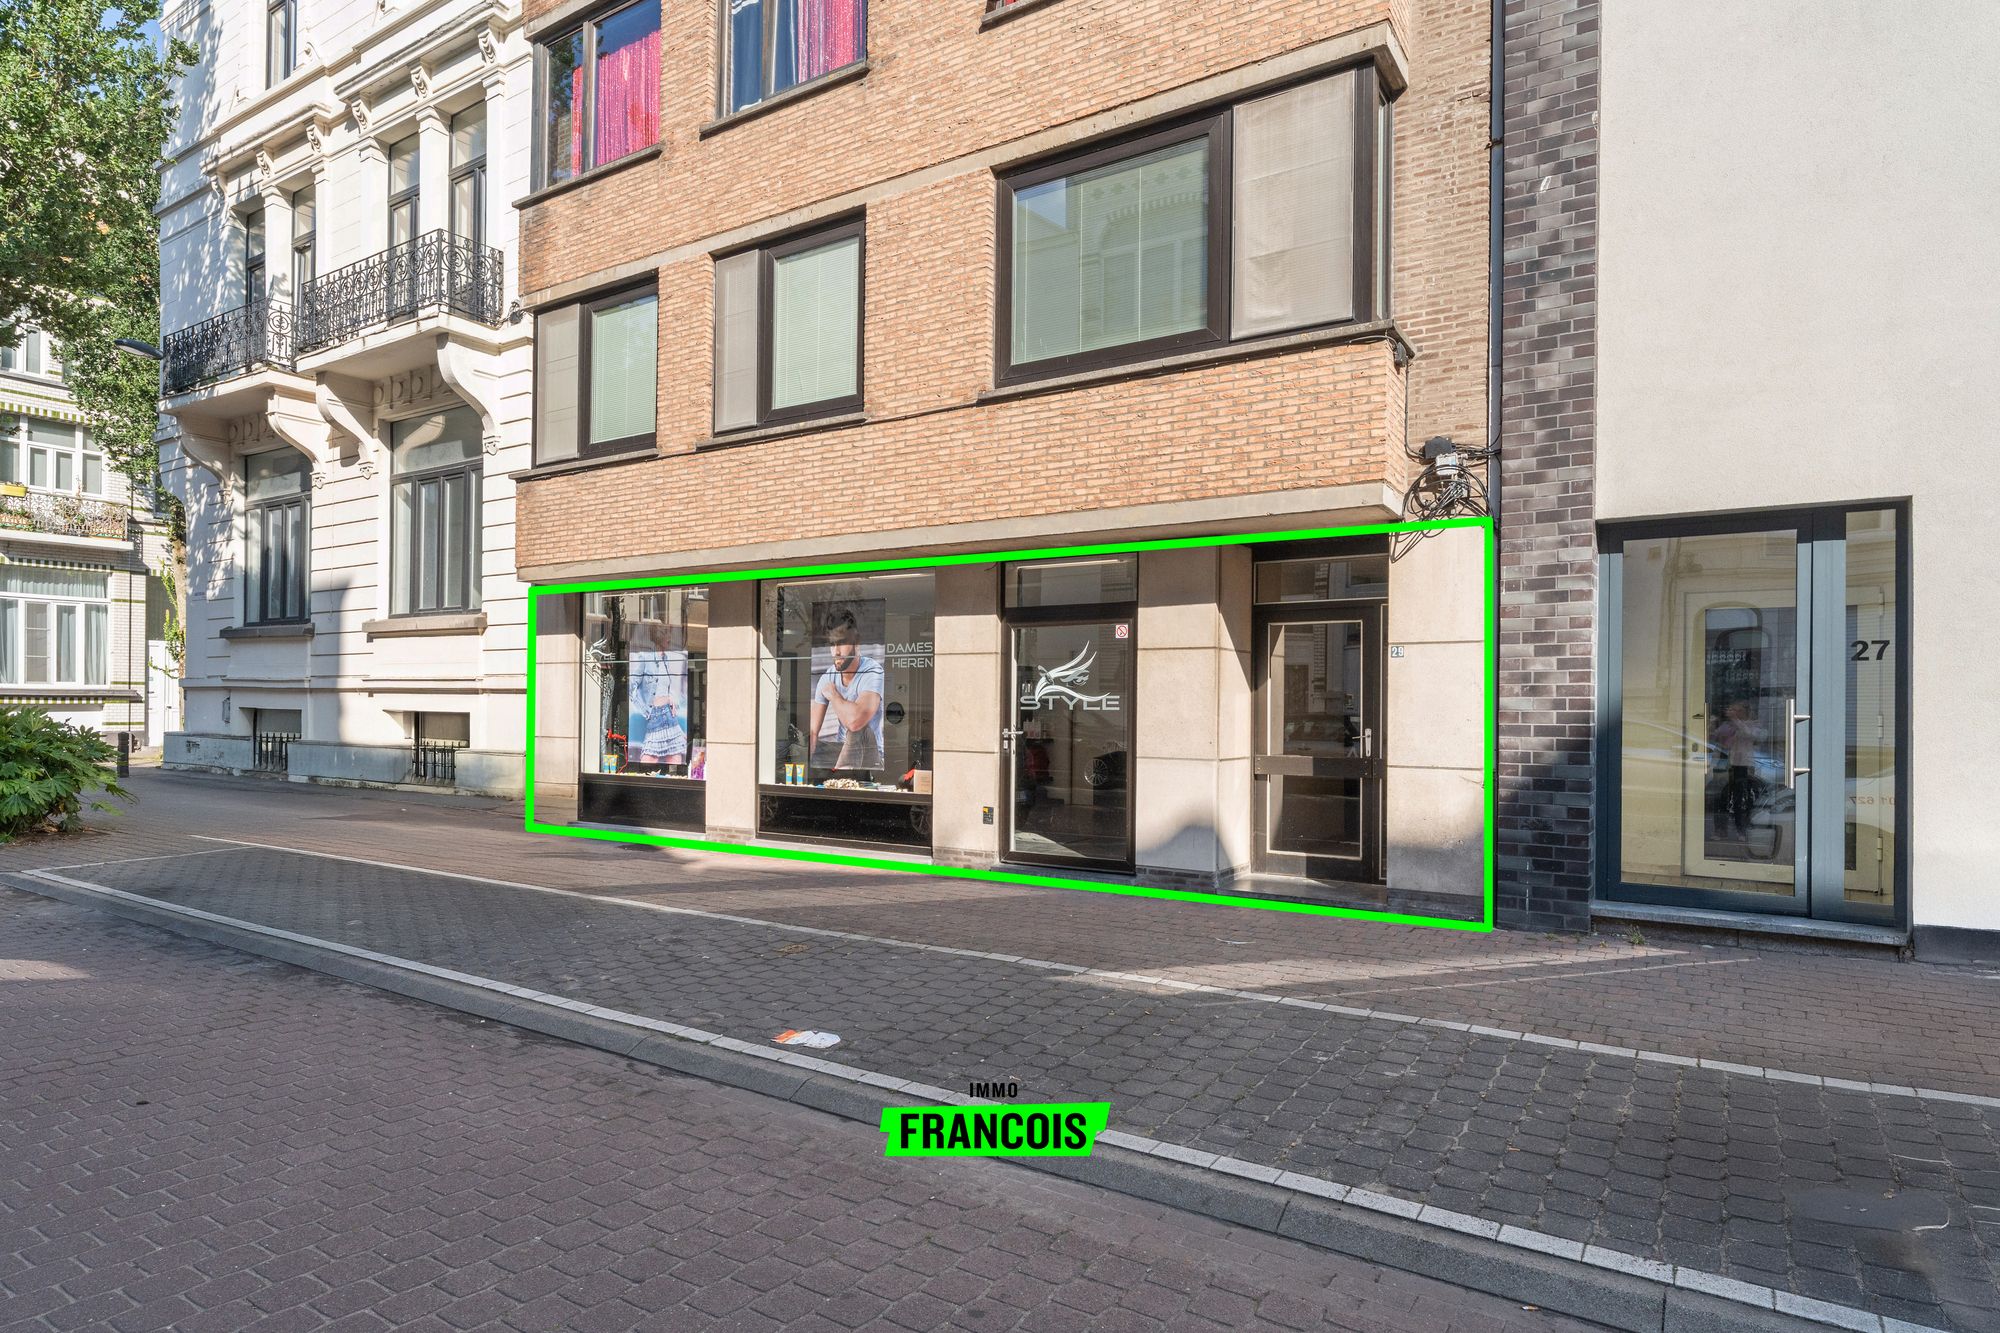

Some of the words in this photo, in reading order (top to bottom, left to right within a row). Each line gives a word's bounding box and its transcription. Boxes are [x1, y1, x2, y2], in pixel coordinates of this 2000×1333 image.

[886, 641, 933, 653] DAMES
[1391, 646, 1404, 657] 29
[1850, 640, 1890, 661] 27
[891, 656, 933, 668] HEREN
[1020, 695, 1120, 711] STYLE
